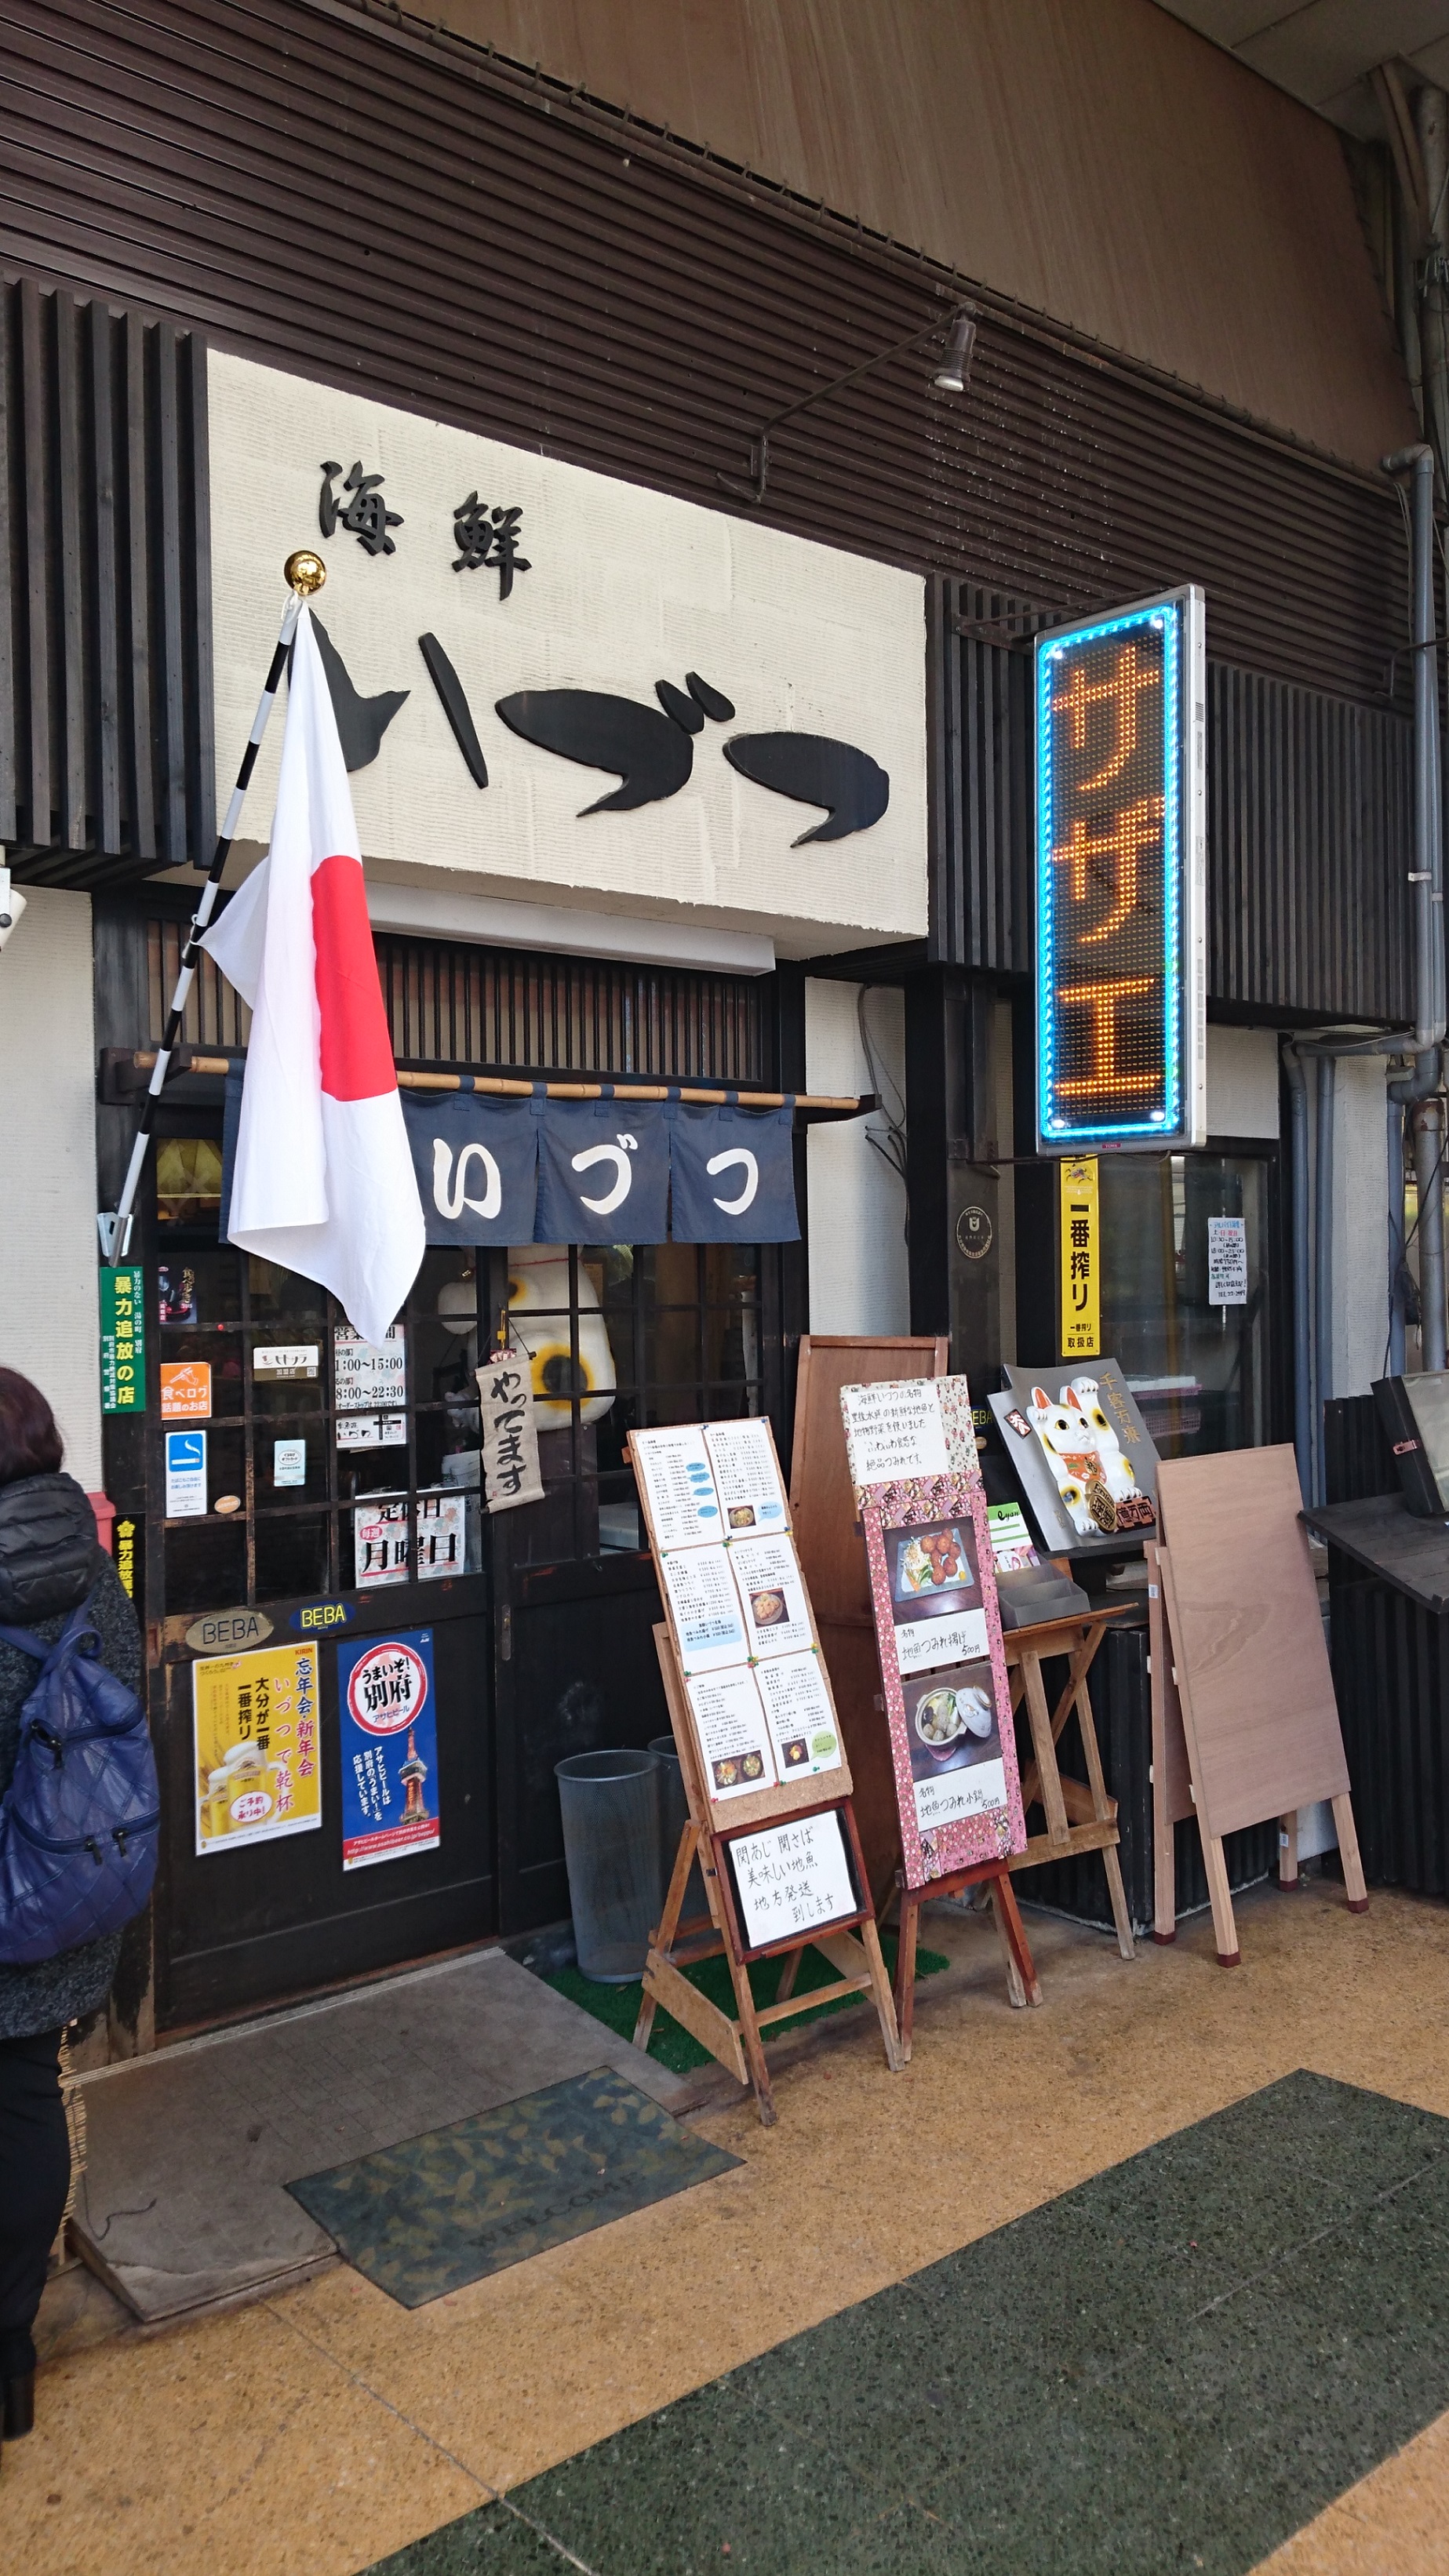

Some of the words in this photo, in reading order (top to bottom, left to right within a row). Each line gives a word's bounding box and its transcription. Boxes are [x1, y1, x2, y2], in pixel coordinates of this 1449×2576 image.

[319, 460, 531, 601] 海鮮
[1052, 646, 1166, 1096] サザエ
[433, 1133, 759, 1219] いづつ
[1070, 1205, 1090, 1312] 一番搾り
[115, 1276, 135, 1404] 暴力追放の店
[1067, 1336, 1094, 1348] 取扱店
[1069, 1323, 1091, 1332] 一番搾り
[135, 1340, 142, 1354] 別府
[162, 1384, 208, 1400] 食べログ
[162, 1401, 208, 1413] 話題のお店
[490, 1371, 526, 1497] やってます
[970, 1410, 993, 1425] EBA
[362, 1527, 380, 1539] 毎週
[362, 1533, 457, 1573] 月曜日
[202, 1617, 259, 1645] BEBA
[300, 1604, 346, 1628] BEBA
[962, 1643, 981, 1656] 500円
[362, 1657, 410, 1685] うまいぞ!
[238, 1684, 253, 1741] 一番搾り
[363, 1674, 413, 1713] 別府
[256, 1677, 270, 1750] 大分が一番
[295, 1657, 315, 1777] 忘年会・新年会
[373, 1705, 410, 1723] アサヒビール
[275, 1678, 293, 1812] いづつで乾杯
[353, 1754, 372, 1817] 応援しています。
[374, 1745, 391, 1806] アサヒビールは
[238, 1806, 265, 1820] 承り中!
[239, 1796, 264, 1808] ご予約
[981, 1796, 1000, 1810] 500円
[736, 1839, 771, 1868] 関あじ
[777, 1825, 814, 1854] 関さば
[748, 1851, 818, 1889] 美味しい地魚
[754, 1880, 814, 1912] 地方発送
[464, 2171, 646, 2248] WELCOME
